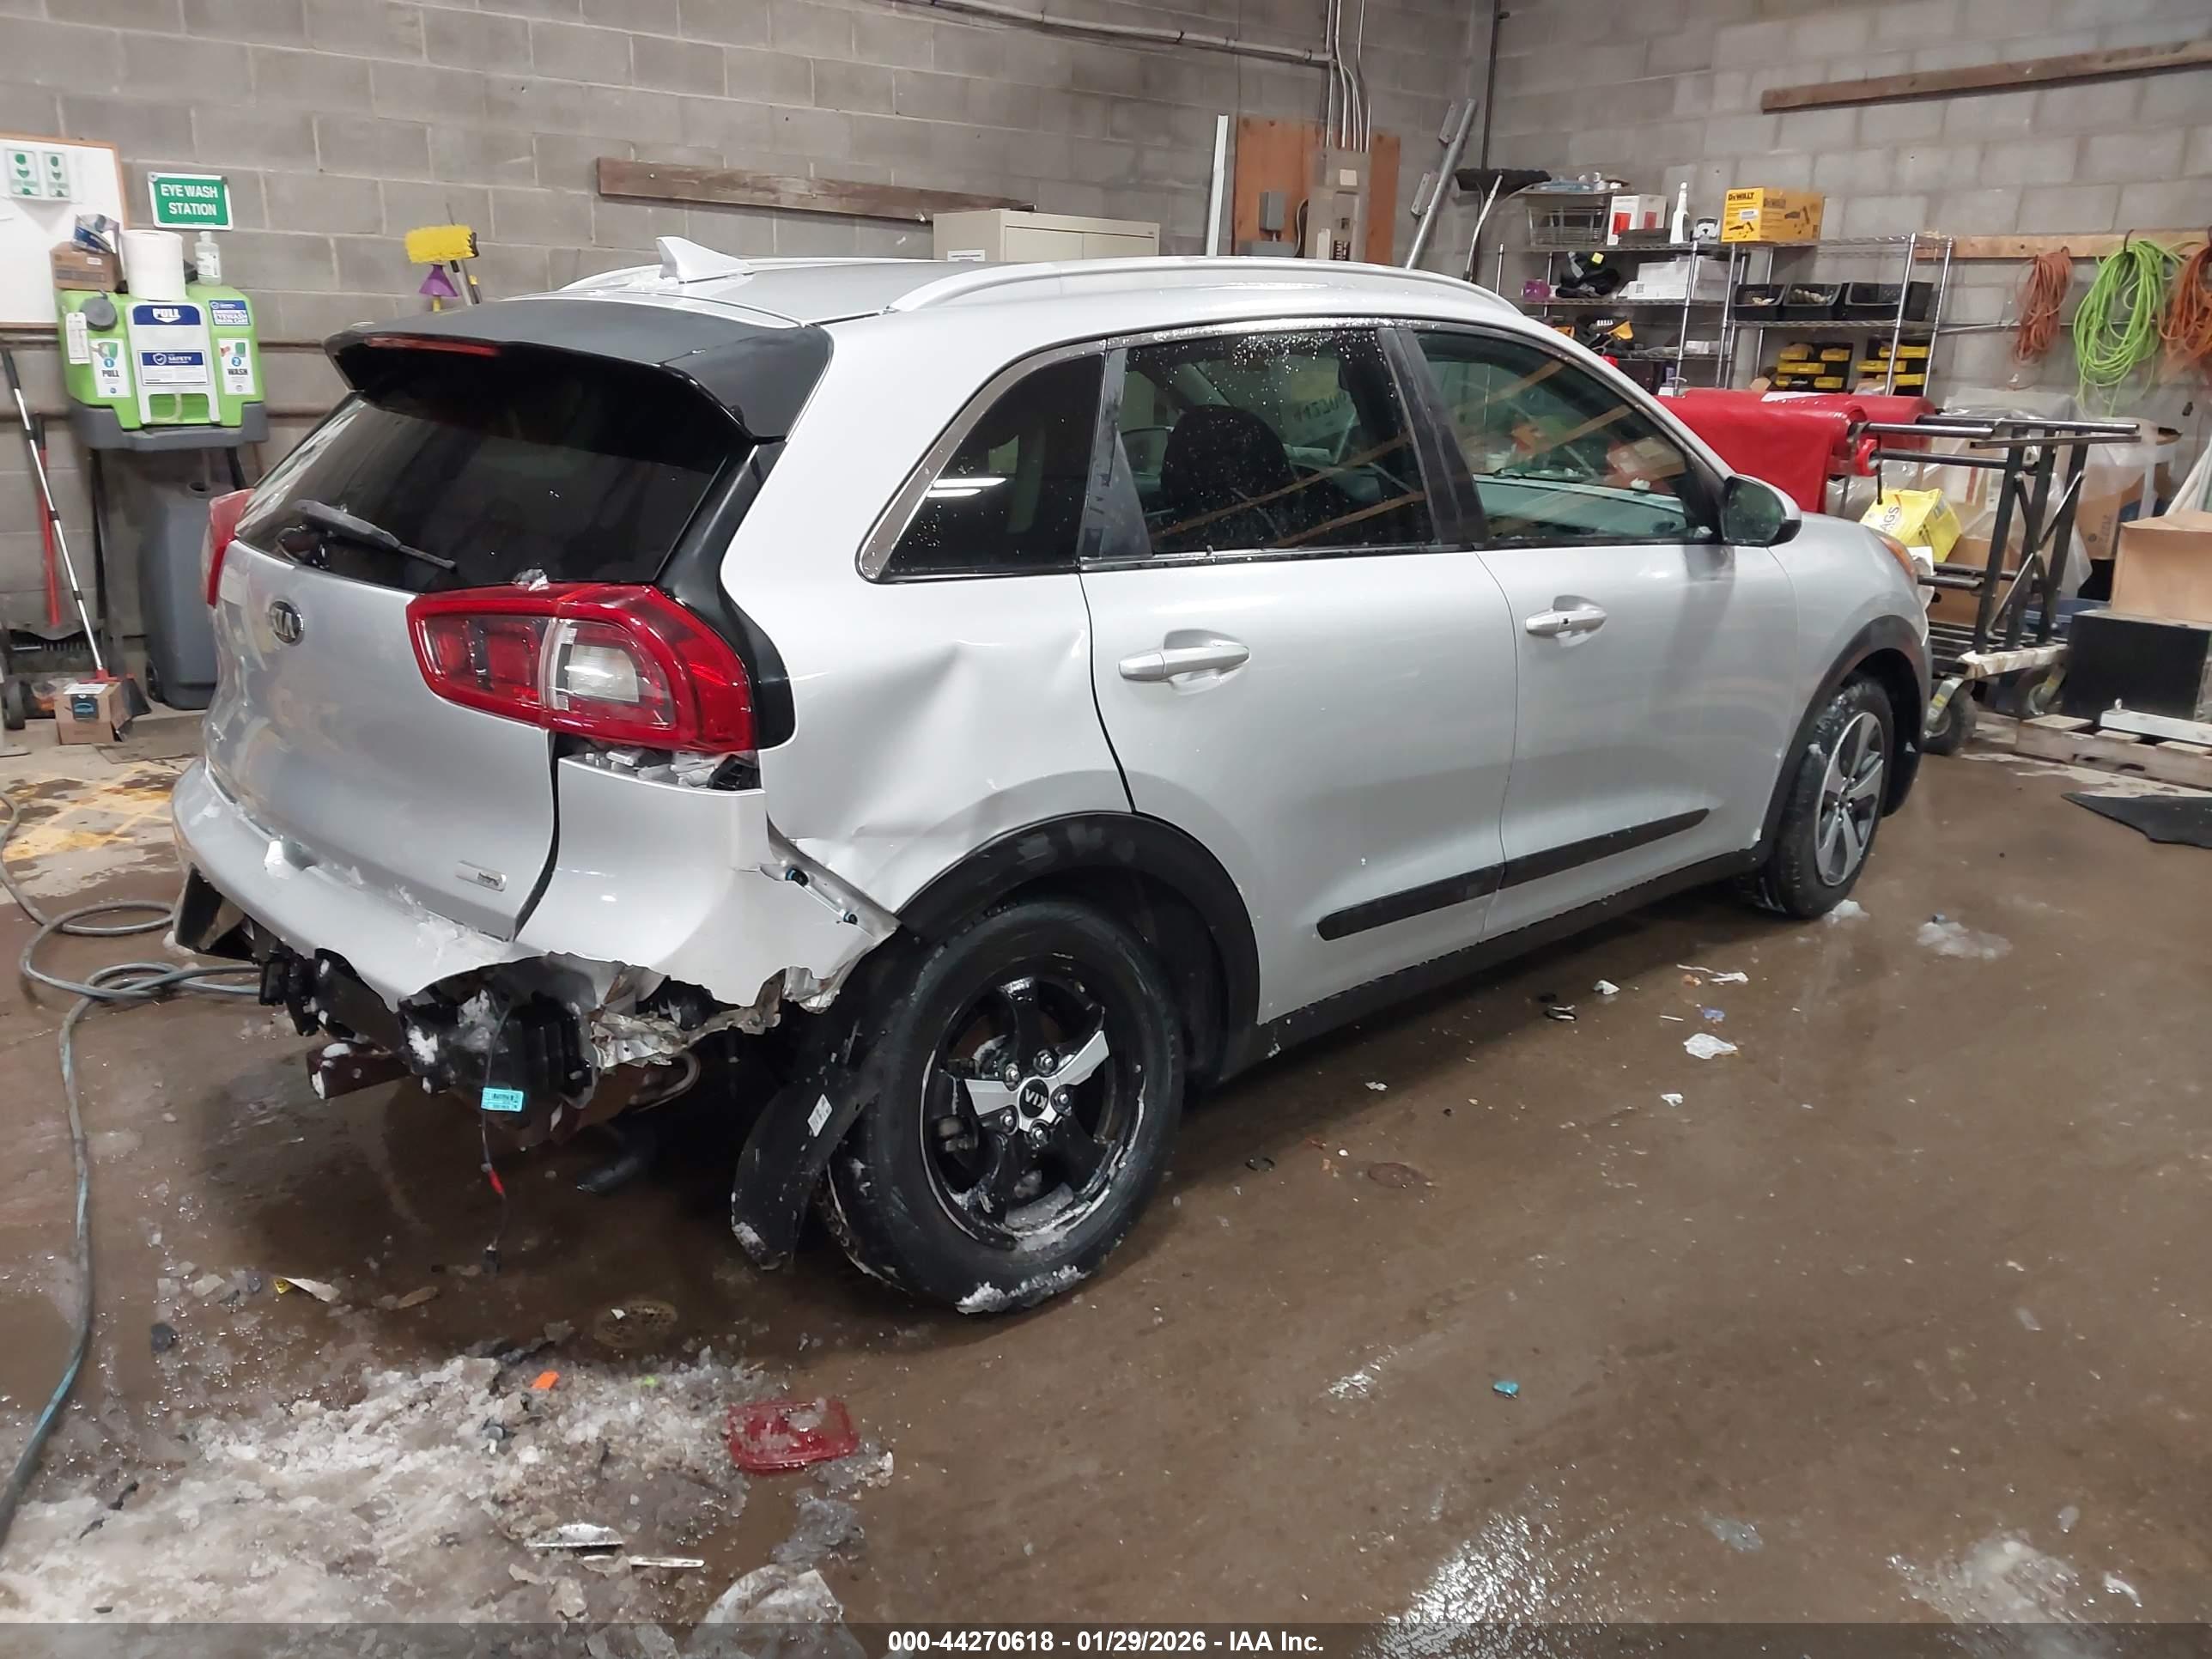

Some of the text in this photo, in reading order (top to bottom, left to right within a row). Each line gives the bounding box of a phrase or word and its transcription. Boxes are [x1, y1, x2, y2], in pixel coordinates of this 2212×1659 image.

[160, 183, 218, 198] EYE WASH
[168, 202, 217, 216] STATION
[152, 307, 180, 318] PULL
[1024, 1087, 1048, 1109] KIA
